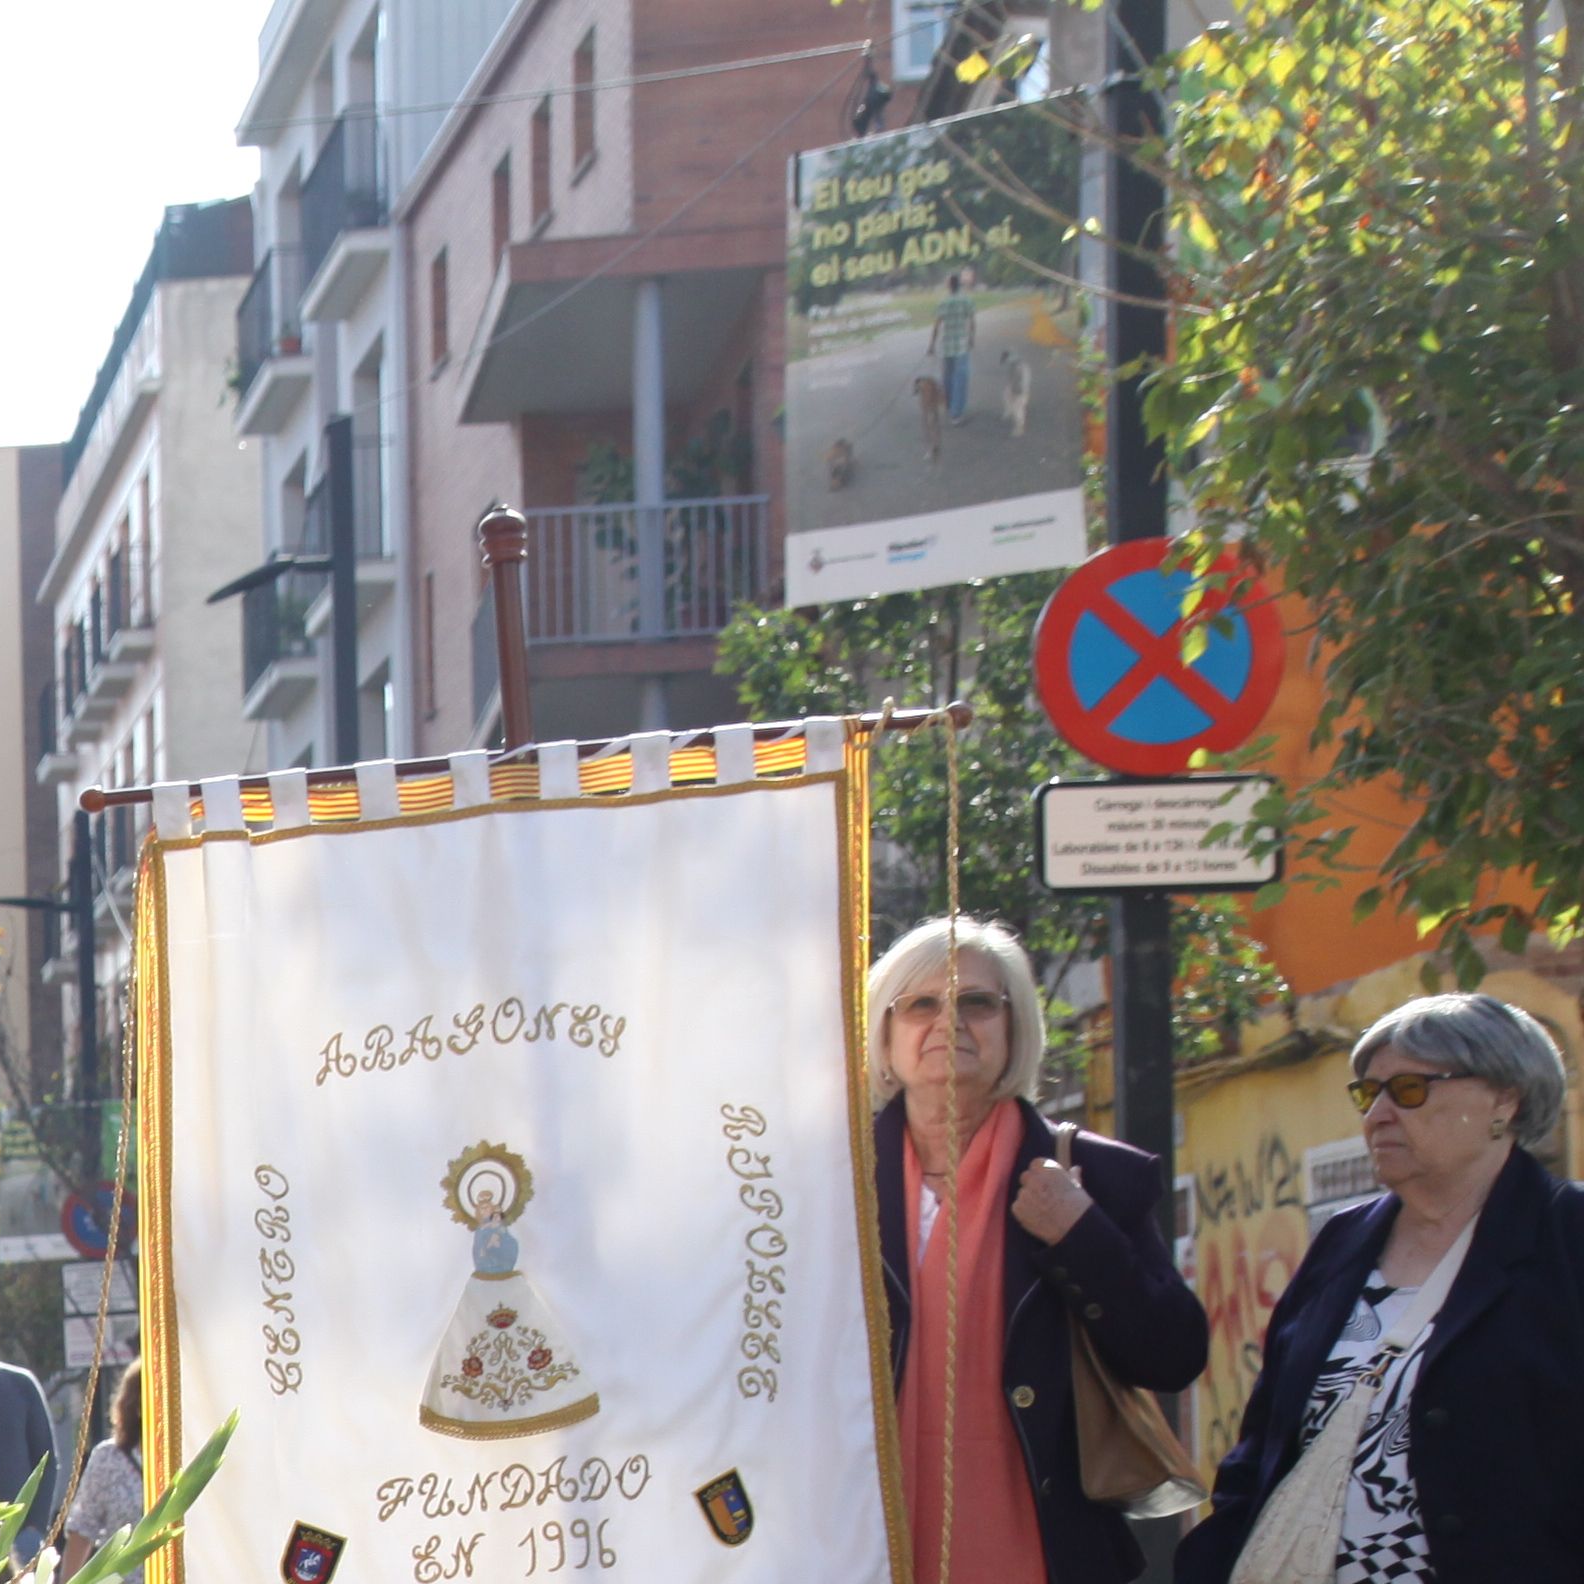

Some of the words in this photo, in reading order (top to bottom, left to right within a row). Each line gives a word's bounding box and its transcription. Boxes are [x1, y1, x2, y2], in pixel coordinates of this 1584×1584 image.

[815, 176, 841, 212] El
[845, 172, 894, 204] teu
[898, 158, 951, 200] gos
[810, 252, 841, 288] el
[843, 249, 896, 282] seu
[899, 223, 980, 268] ADN,
[812, 220, 851, 250] no
[315, 997, 627, 1087] ARAGONES
[720, 1103, 788, 1403] RIPOLLET
[376, 1454, 652, 1522] FUNDADO
[412, 1532, 486, 1584] EN
[518, 1518, 617, 1577] 1996
